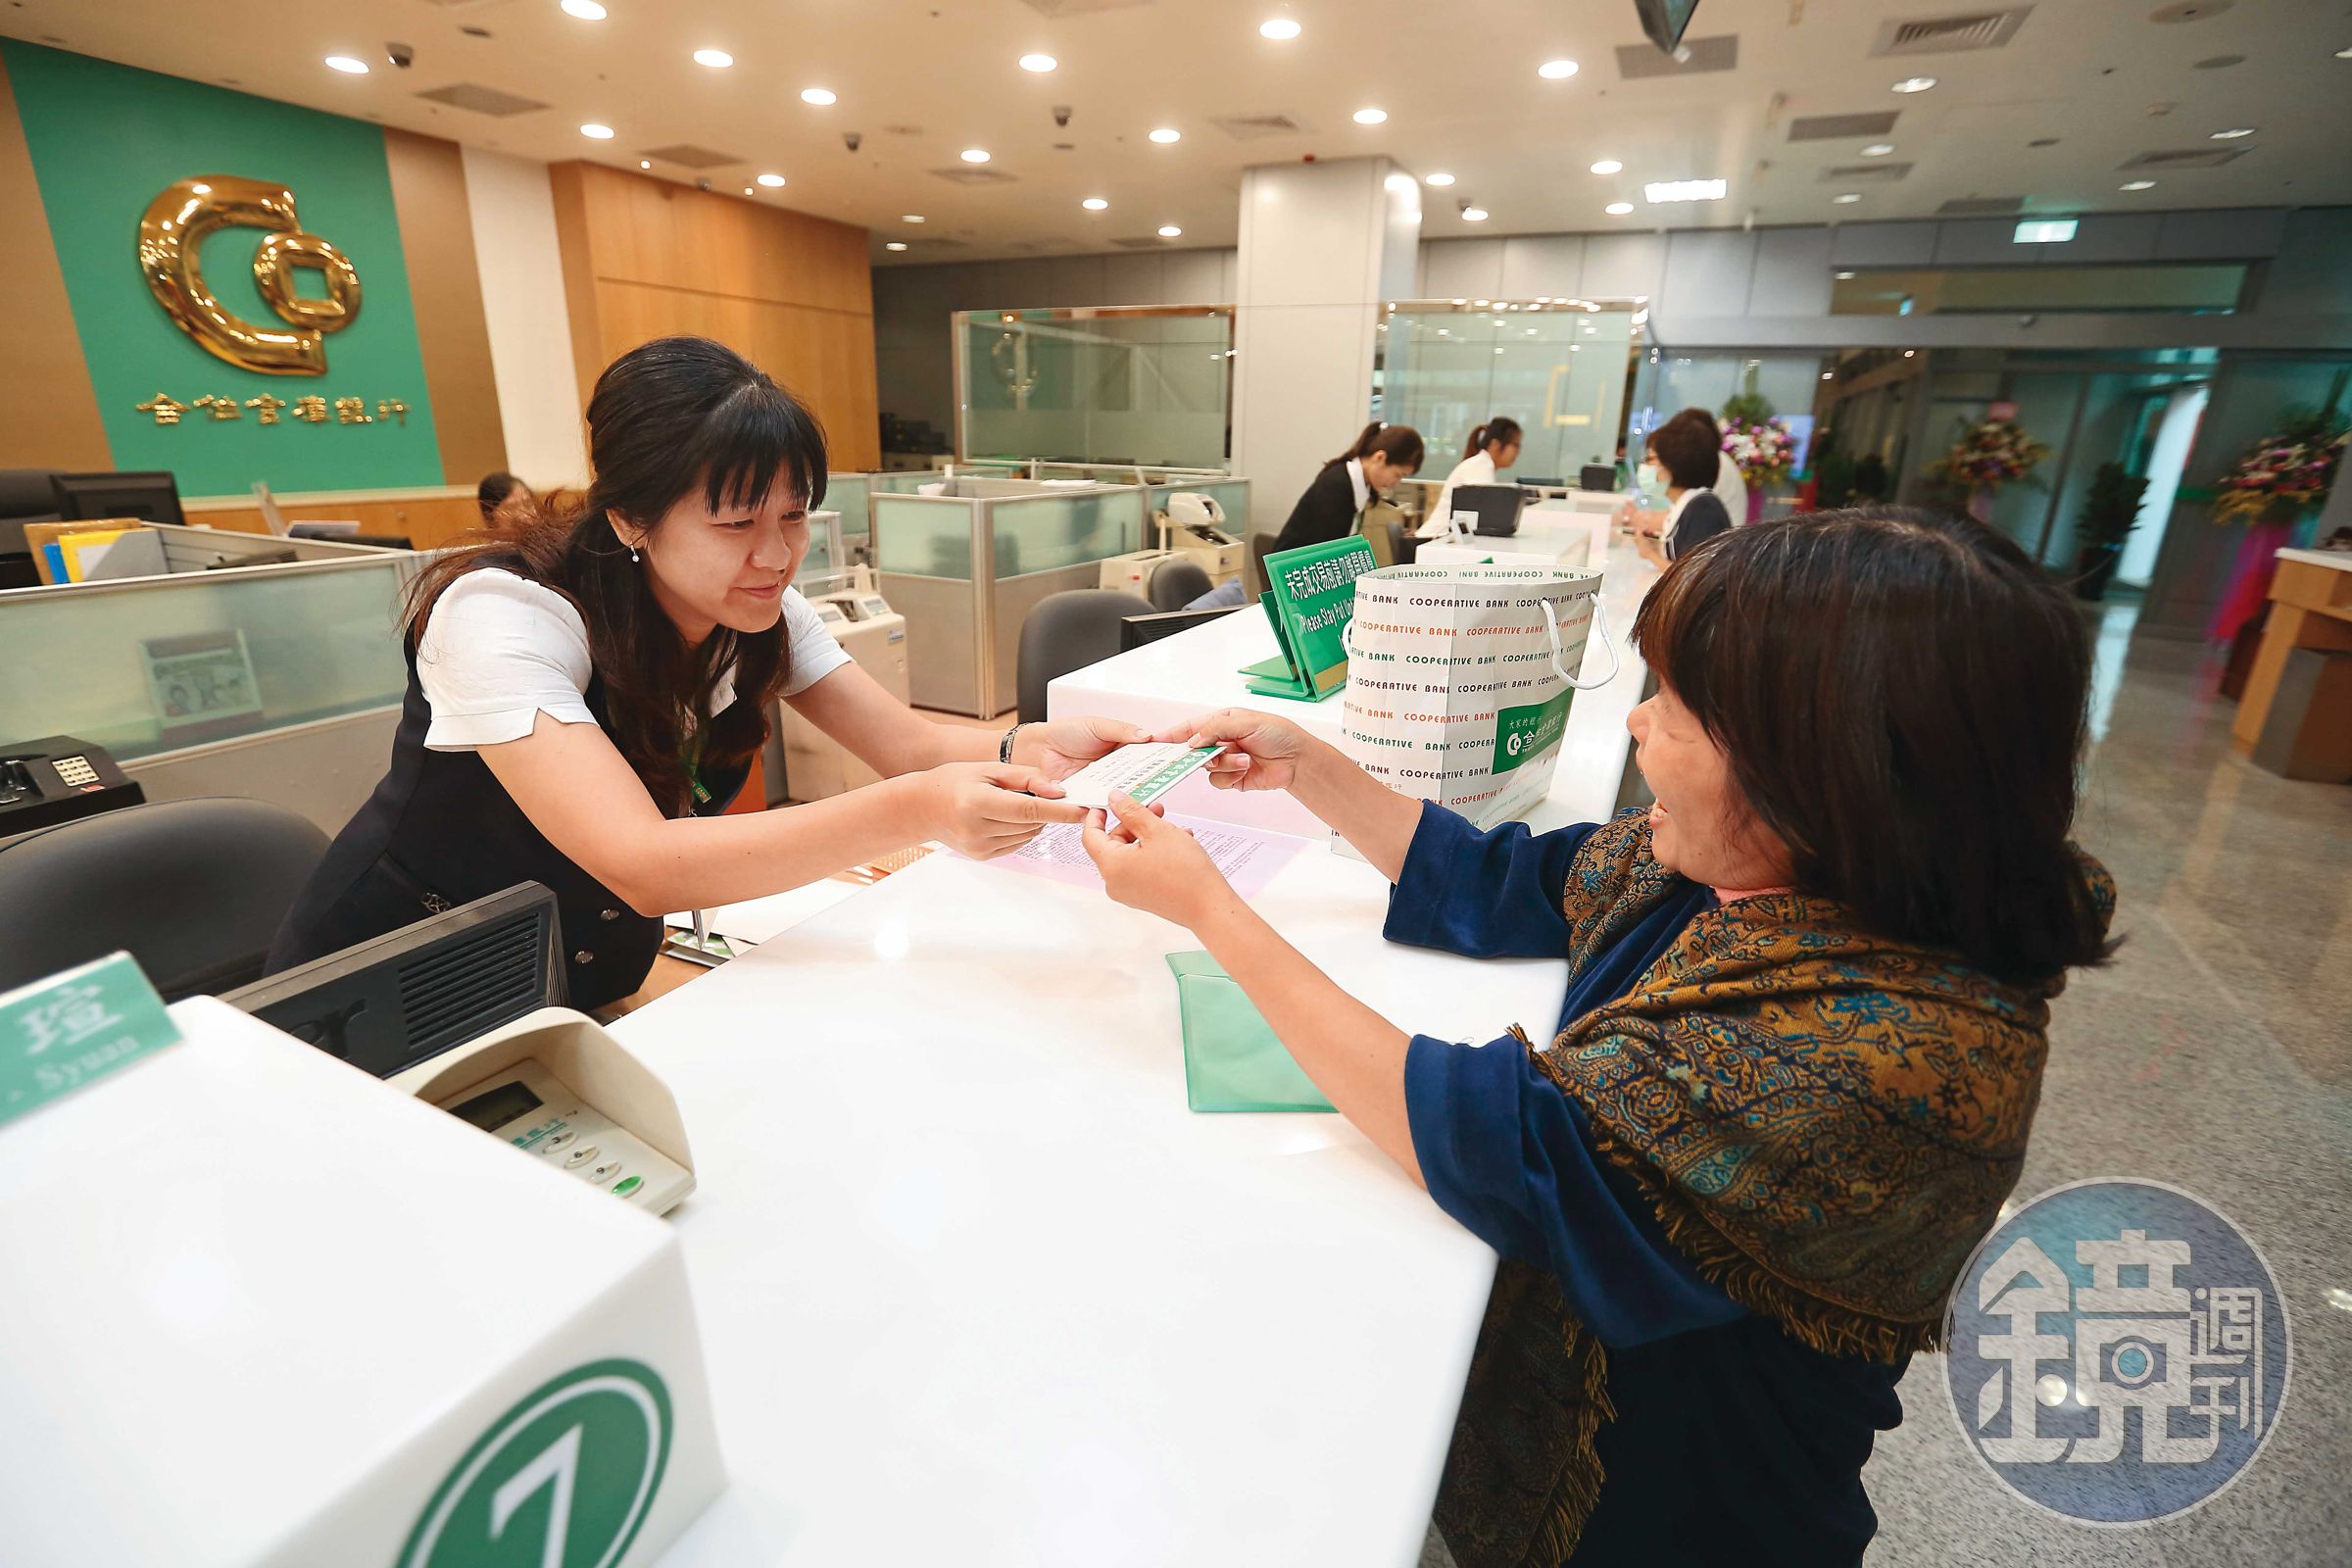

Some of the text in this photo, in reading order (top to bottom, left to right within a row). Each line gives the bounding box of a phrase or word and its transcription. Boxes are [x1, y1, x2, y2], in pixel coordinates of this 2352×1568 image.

[1372, 594, 1398, 605] BANK
[1409, 598, 1479, 608] COOPERATIVE
[1300, 613, 1323, 633] Please
[1319, 608, 1338, 627] Stay
[1359, 620, 1421, 635] COOPERATIVE
[1429, 627, 1457, 637] BANK
[1466, 627, 1521, 636] COOPERATIVE
[1525, 625, 1544, 634] BANK
[1368, 653, 1396, 662] BANK
[1477, 655, 1496, 664] BANK
[1502, 651, 1550, 662] COOPERATIVE
[1355, 676, 1417, 692] COOPERATIVE
[1511, 679, 1533, 688] BANK
[1367, 709, 1394, 719] BANK
[1403, 712, 1469, 723] COOPERATIVE
[1474, 712, 1495, 721] BANK
[1352, 731, 1413, 749] COOPERATIVE
[1425, 742, 1451, 752] BANK
[1365, 763, 1490, 780] BANK COOPERATIVE BANK
[1450, 789, 1496, 806] COOPERATIVE
